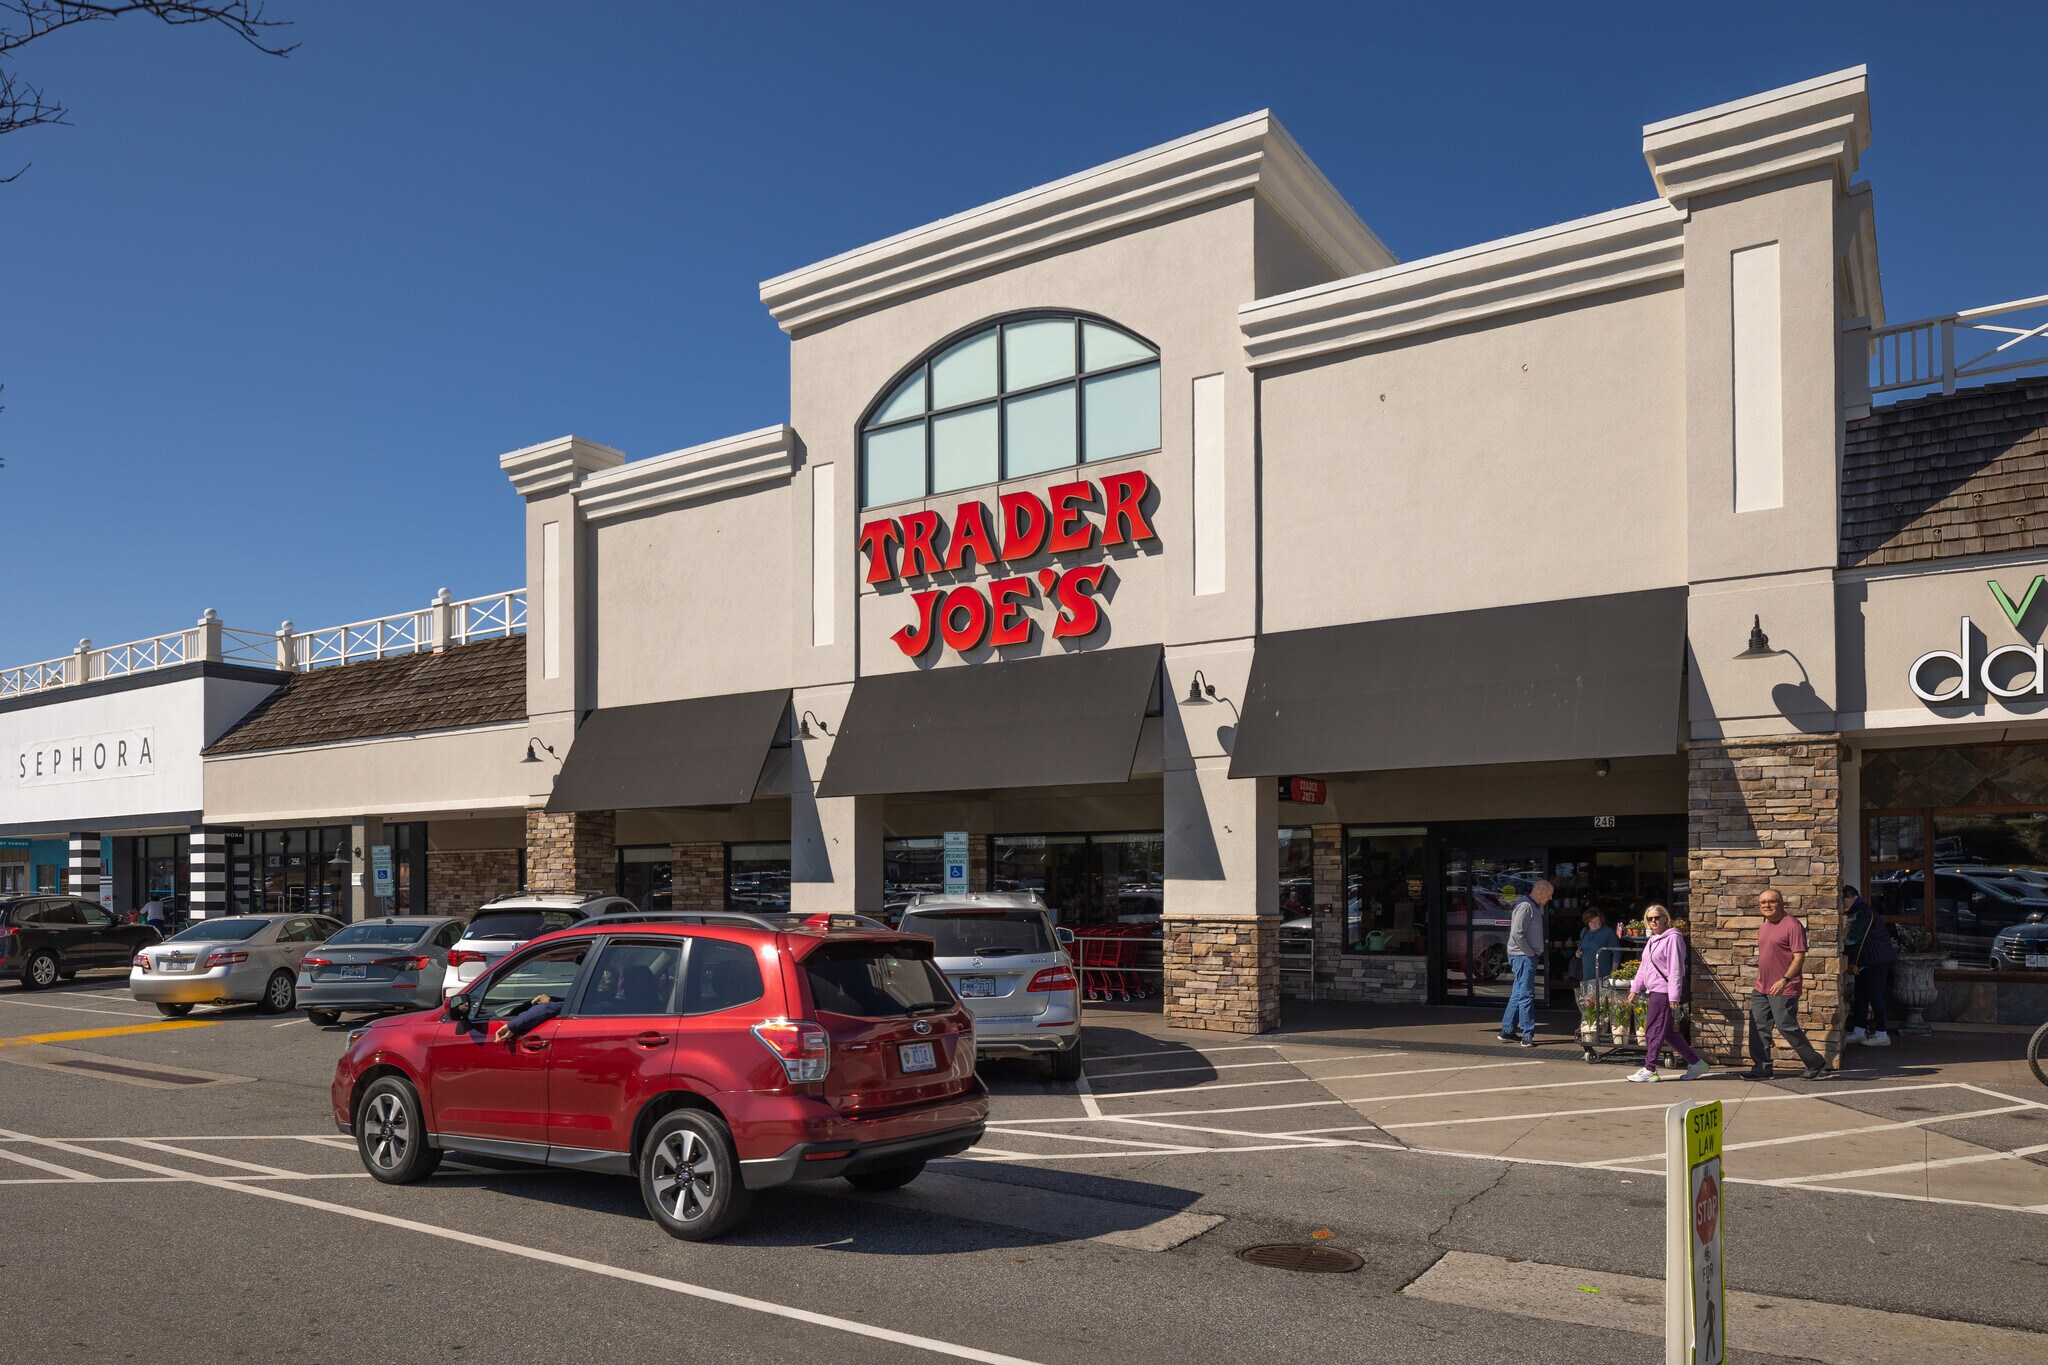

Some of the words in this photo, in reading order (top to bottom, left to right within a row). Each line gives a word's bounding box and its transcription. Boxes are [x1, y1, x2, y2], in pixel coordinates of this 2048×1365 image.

[858, 470, 1154, 584] TRADER
[890, 564, 1110, 657] JOE'S
[1908, 616, 2044, 701] da
[19, 737, 152, 778] SEPHORA
[1300, 780, 1317, 792] TRADER
[1301, 791, 1315, 802] JOE'S
[1595, 816, 1614, 827] 246
[291, 857, 300, 865] 256
[1693, 1108, 1718, 1134] STATE
[1698, 1133, 1715, 1157] LAW
[1697, 1195, 1717, 1225] STOP
[1702, 1262, 1714, 1281] FOR
